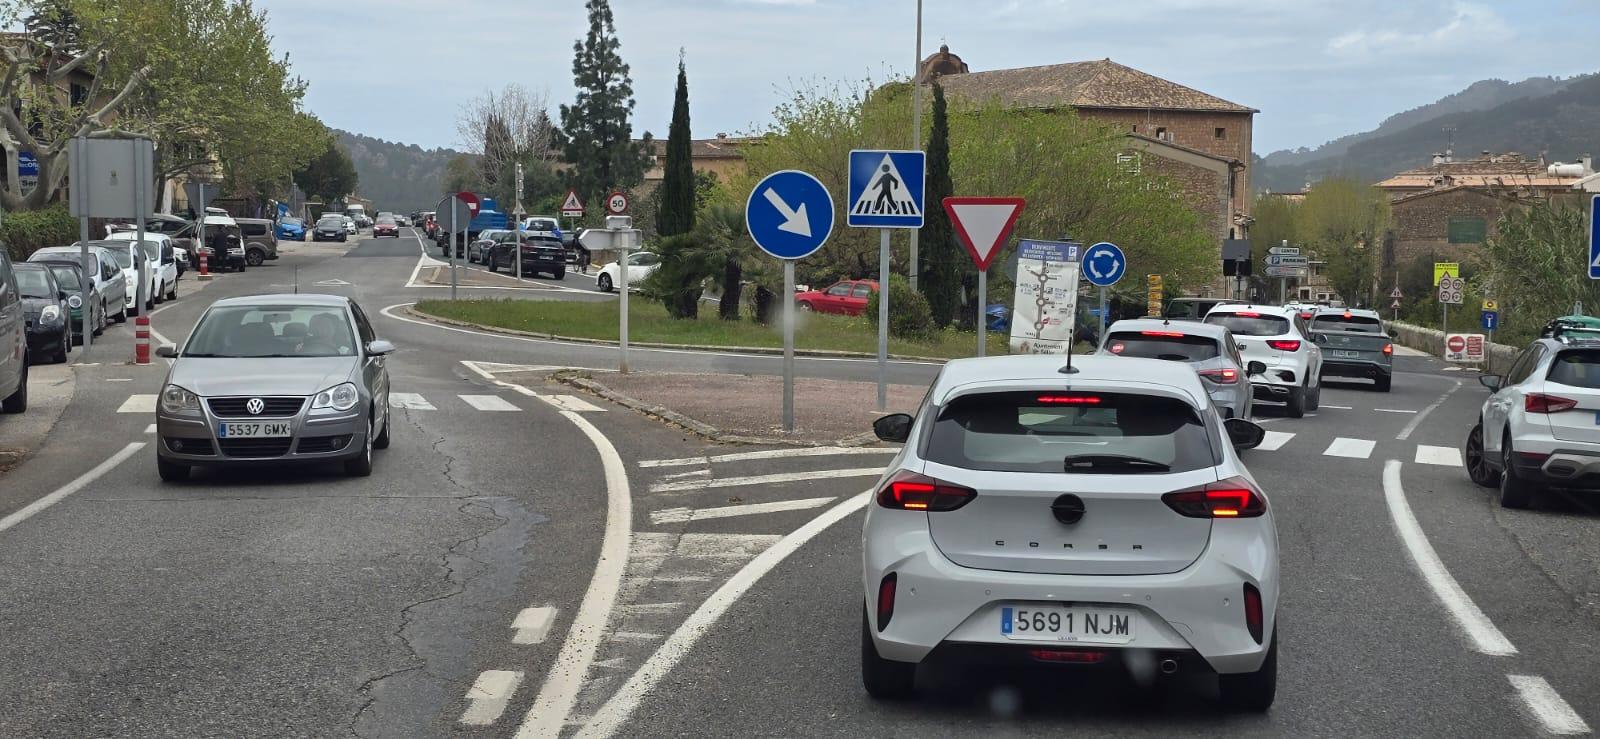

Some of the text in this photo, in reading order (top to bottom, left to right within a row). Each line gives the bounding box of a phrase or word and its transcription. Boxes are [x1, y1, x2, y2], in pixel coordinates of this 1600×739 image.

[612, 200, 624, 208] 50
[228, 423, 288, 436] 5537 GMX
[995, 540, 1143, 550] CORSA
[1017, 611, 1129, 636] 5691 NJM
